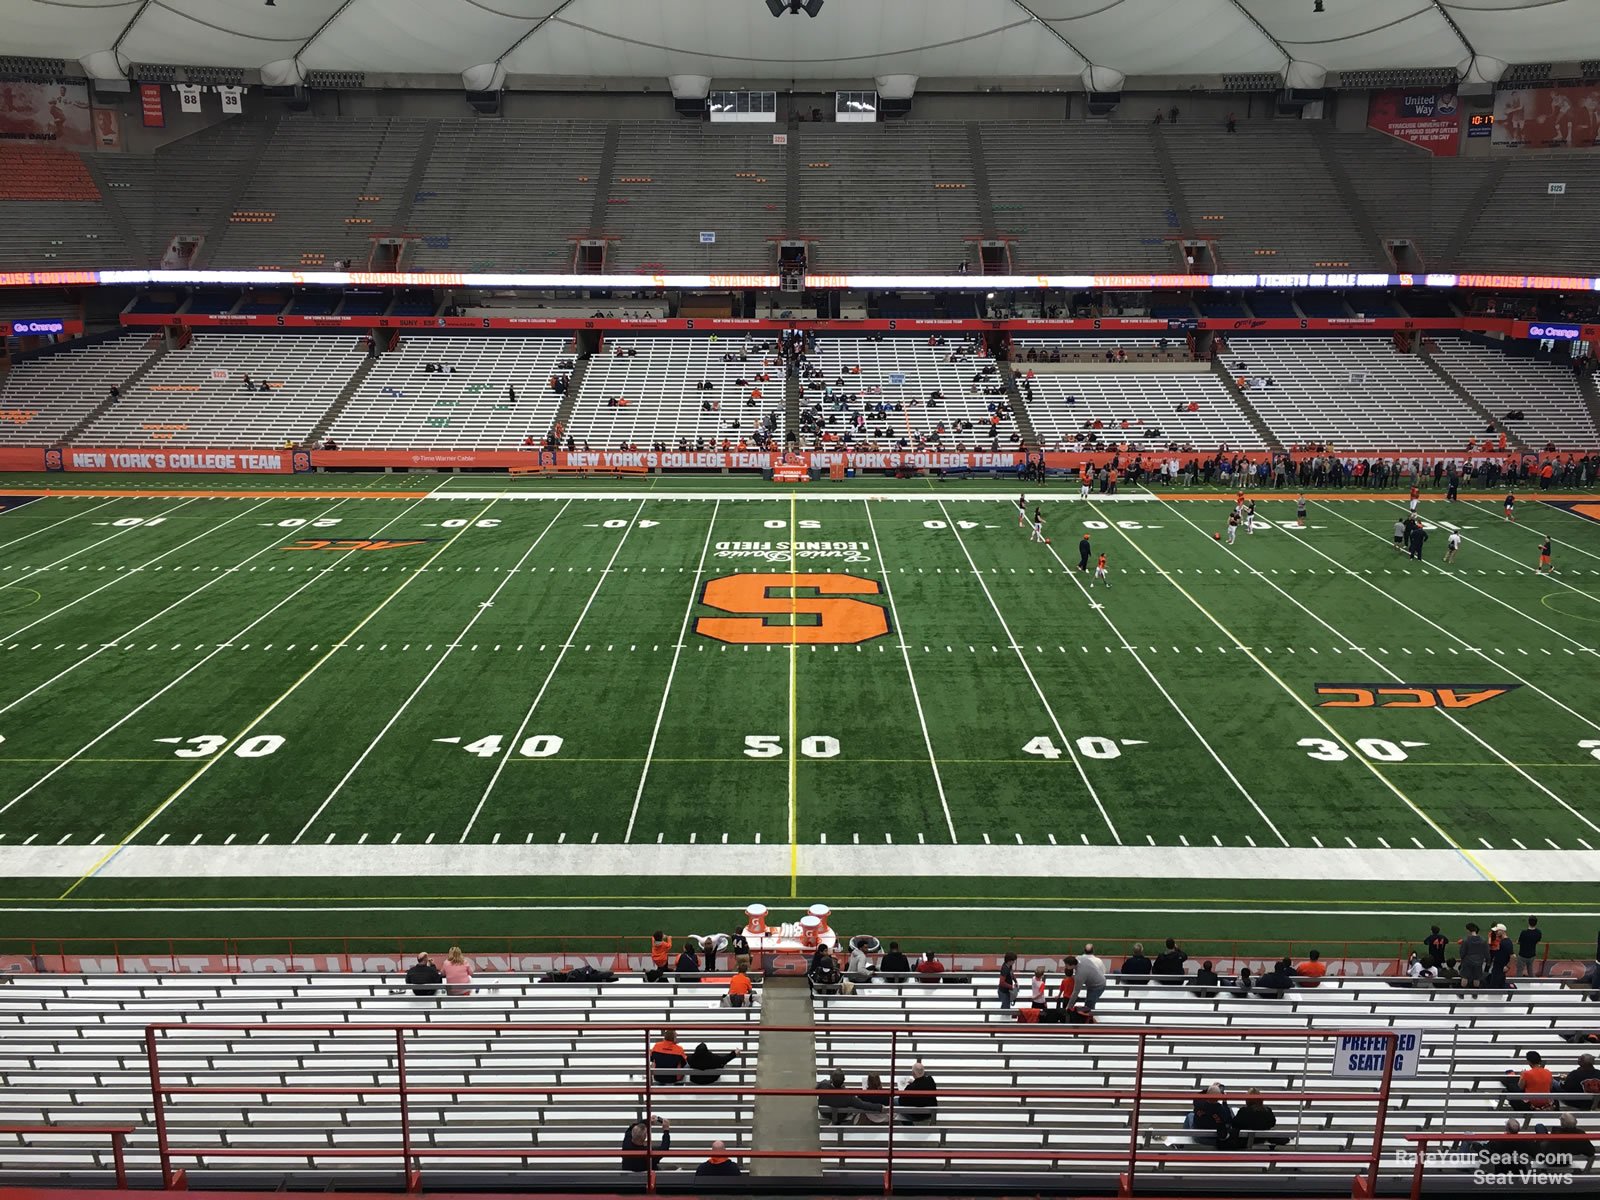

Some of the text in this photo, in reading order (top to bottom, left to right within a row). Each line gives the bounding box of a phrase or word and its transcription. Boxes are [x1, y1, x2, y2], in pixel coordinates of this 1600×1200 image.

[184, 95, 197, 104] 88
[226, 96, 238, 105] 39
[1404, 95, 1435, 105] United
[1415, 105, 1435, 116] Way
[1471, 115, 1494, 125] 10:17
[34, 272, 96, 285] FOOTBALL
[348, 272, 464, 286] SYRACUSE FOOTBALL
[709, 275, 767, 287] SYRACUSE
[1093, 274, 1209, 288] SYRACUSE FOOTBALL
[1259, 274, 1309, 287] TICKETS
[1458, 274, 1524, 289] SYRACUSE
[1526, 276, 1590, 290] FOOTBALL
[13, 322, 63, 333] Go Orange
[1529, 326, 1579, 339] Go Orange
[73, 452, 281, 470] NEW YORK'S COLLEGE TEAM
[420, 454, 474, 462] Time Warner Cable
[567, 452, 771, 468] NEW YORK'S COLLEGE TEAM
[810, 453, 1014, 469] NEW YORK'S COLLEGE TEAM
[276, 518, 344, 527] 20
[440, 518, 502, 528] 30
[602, 519, 661, 528] 40
[763, 519, 823, 529] 50
[922, 519, 979, 530] 40
[1081, 520, 1145, 530] 30
[715, 541, 870, 551] LEGENDS FIELD
[713, 549, 872, 564] Ernie Davis
[691, 572, 894, 645] S
[174, 734, 286, 758] 30
[463, 734, 564, 757] 40
[743, 735, 841, 758] 50
[1021, 735, 1122, 759] 40
[1296, 737, 1410, 762] 30
[751, 918, 760, 926] G
[1348, 1053, 1404, 1071] SEATIG
